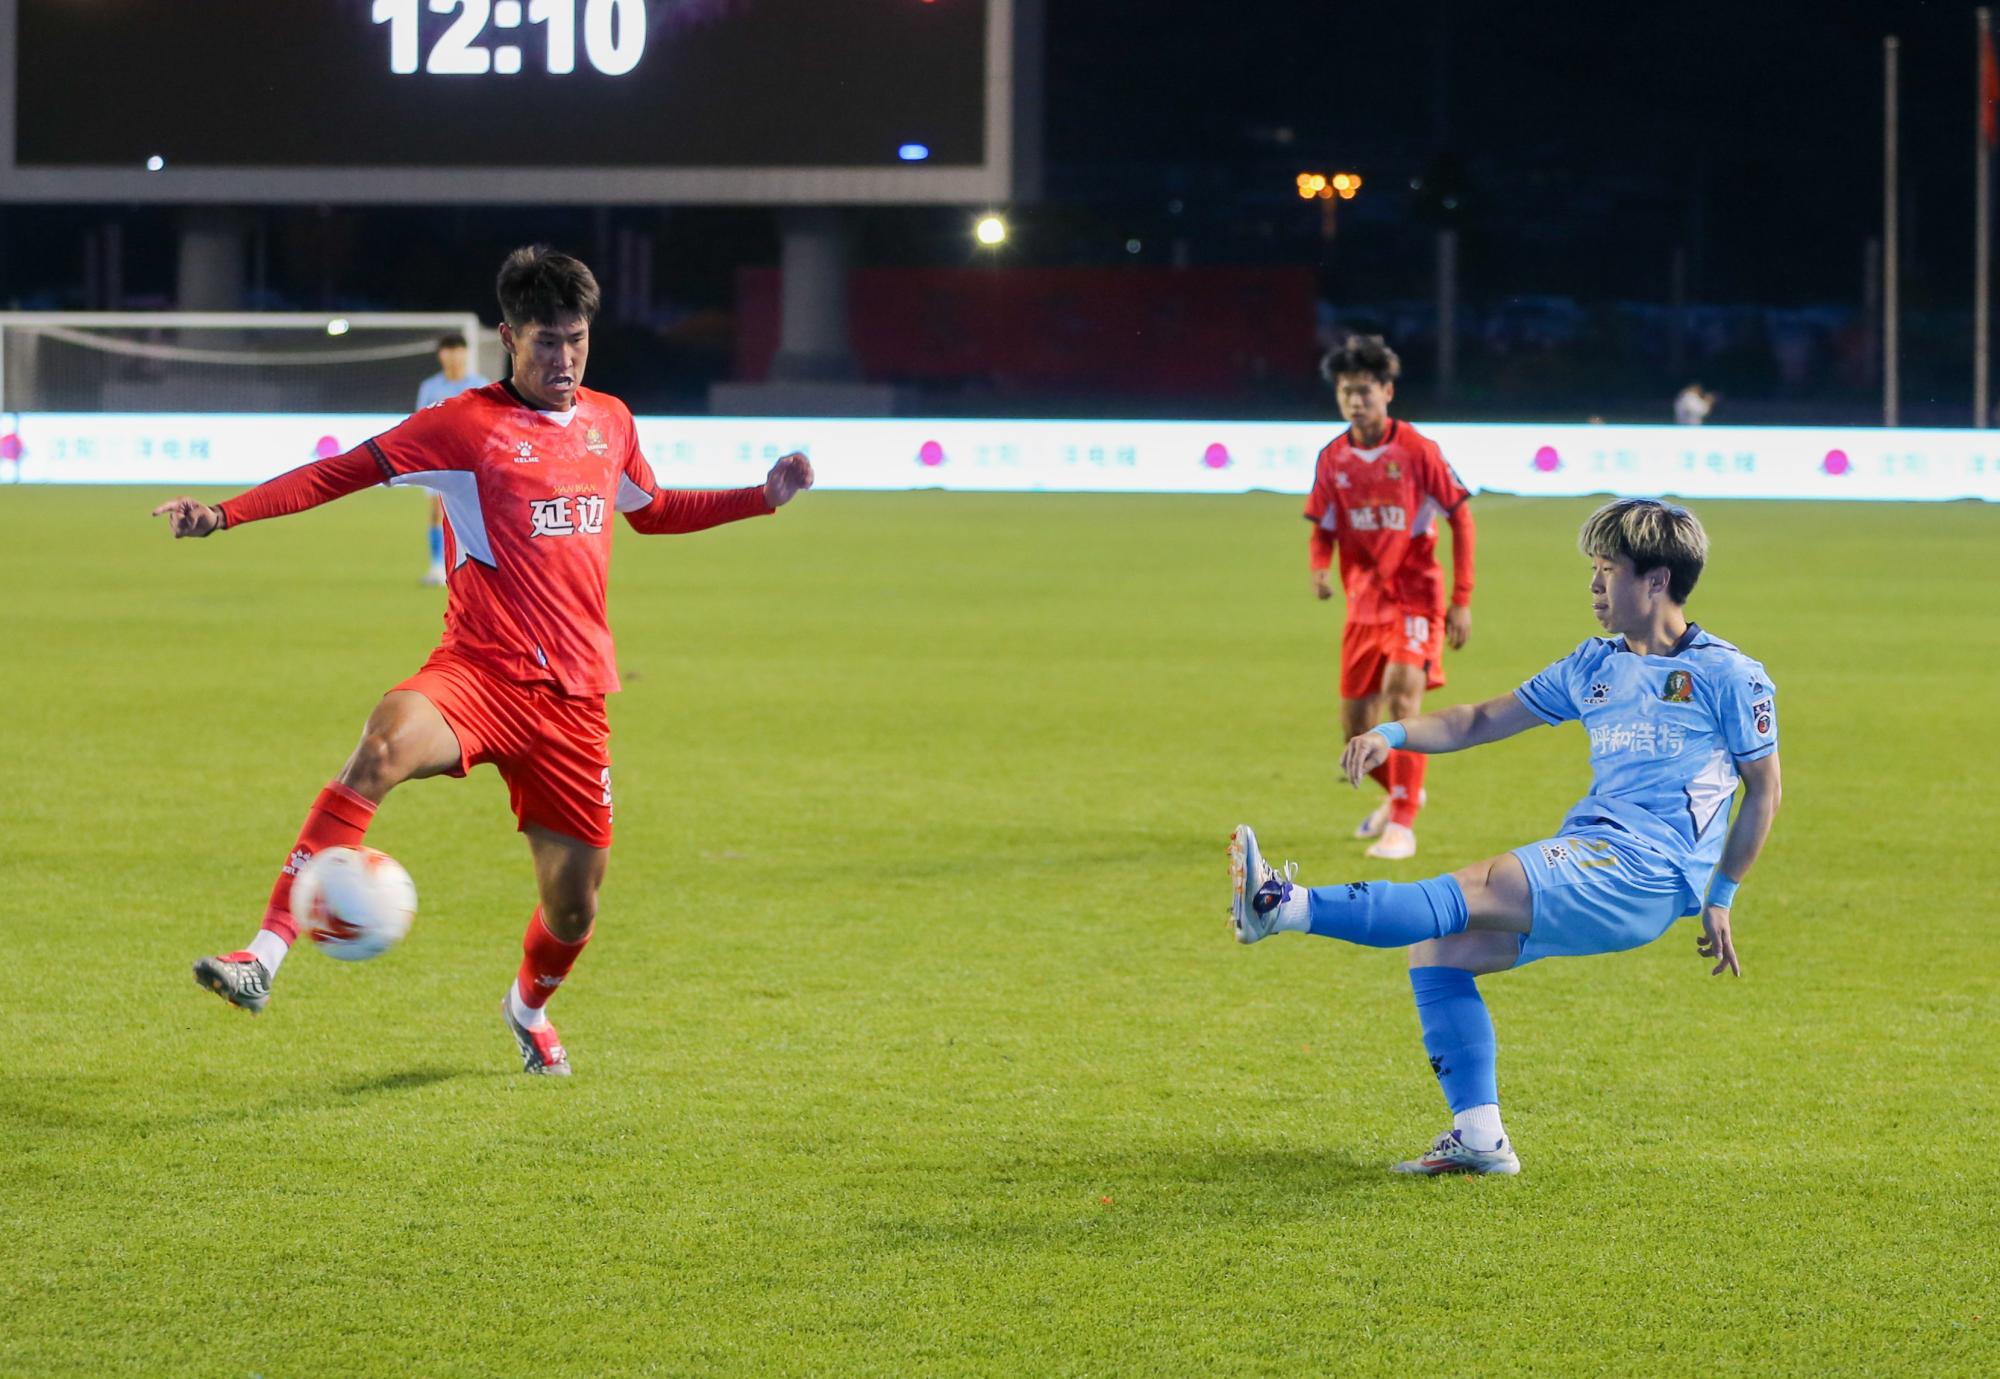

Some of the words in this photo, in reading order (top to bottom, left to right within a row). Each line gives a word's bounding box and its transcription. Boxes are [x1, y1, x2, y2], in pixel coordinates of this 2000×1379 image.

[372, 0, 648, 75] 12:10
[529, 494, 605, 538] 延边
[1404, 616, 1429, 641] 10
